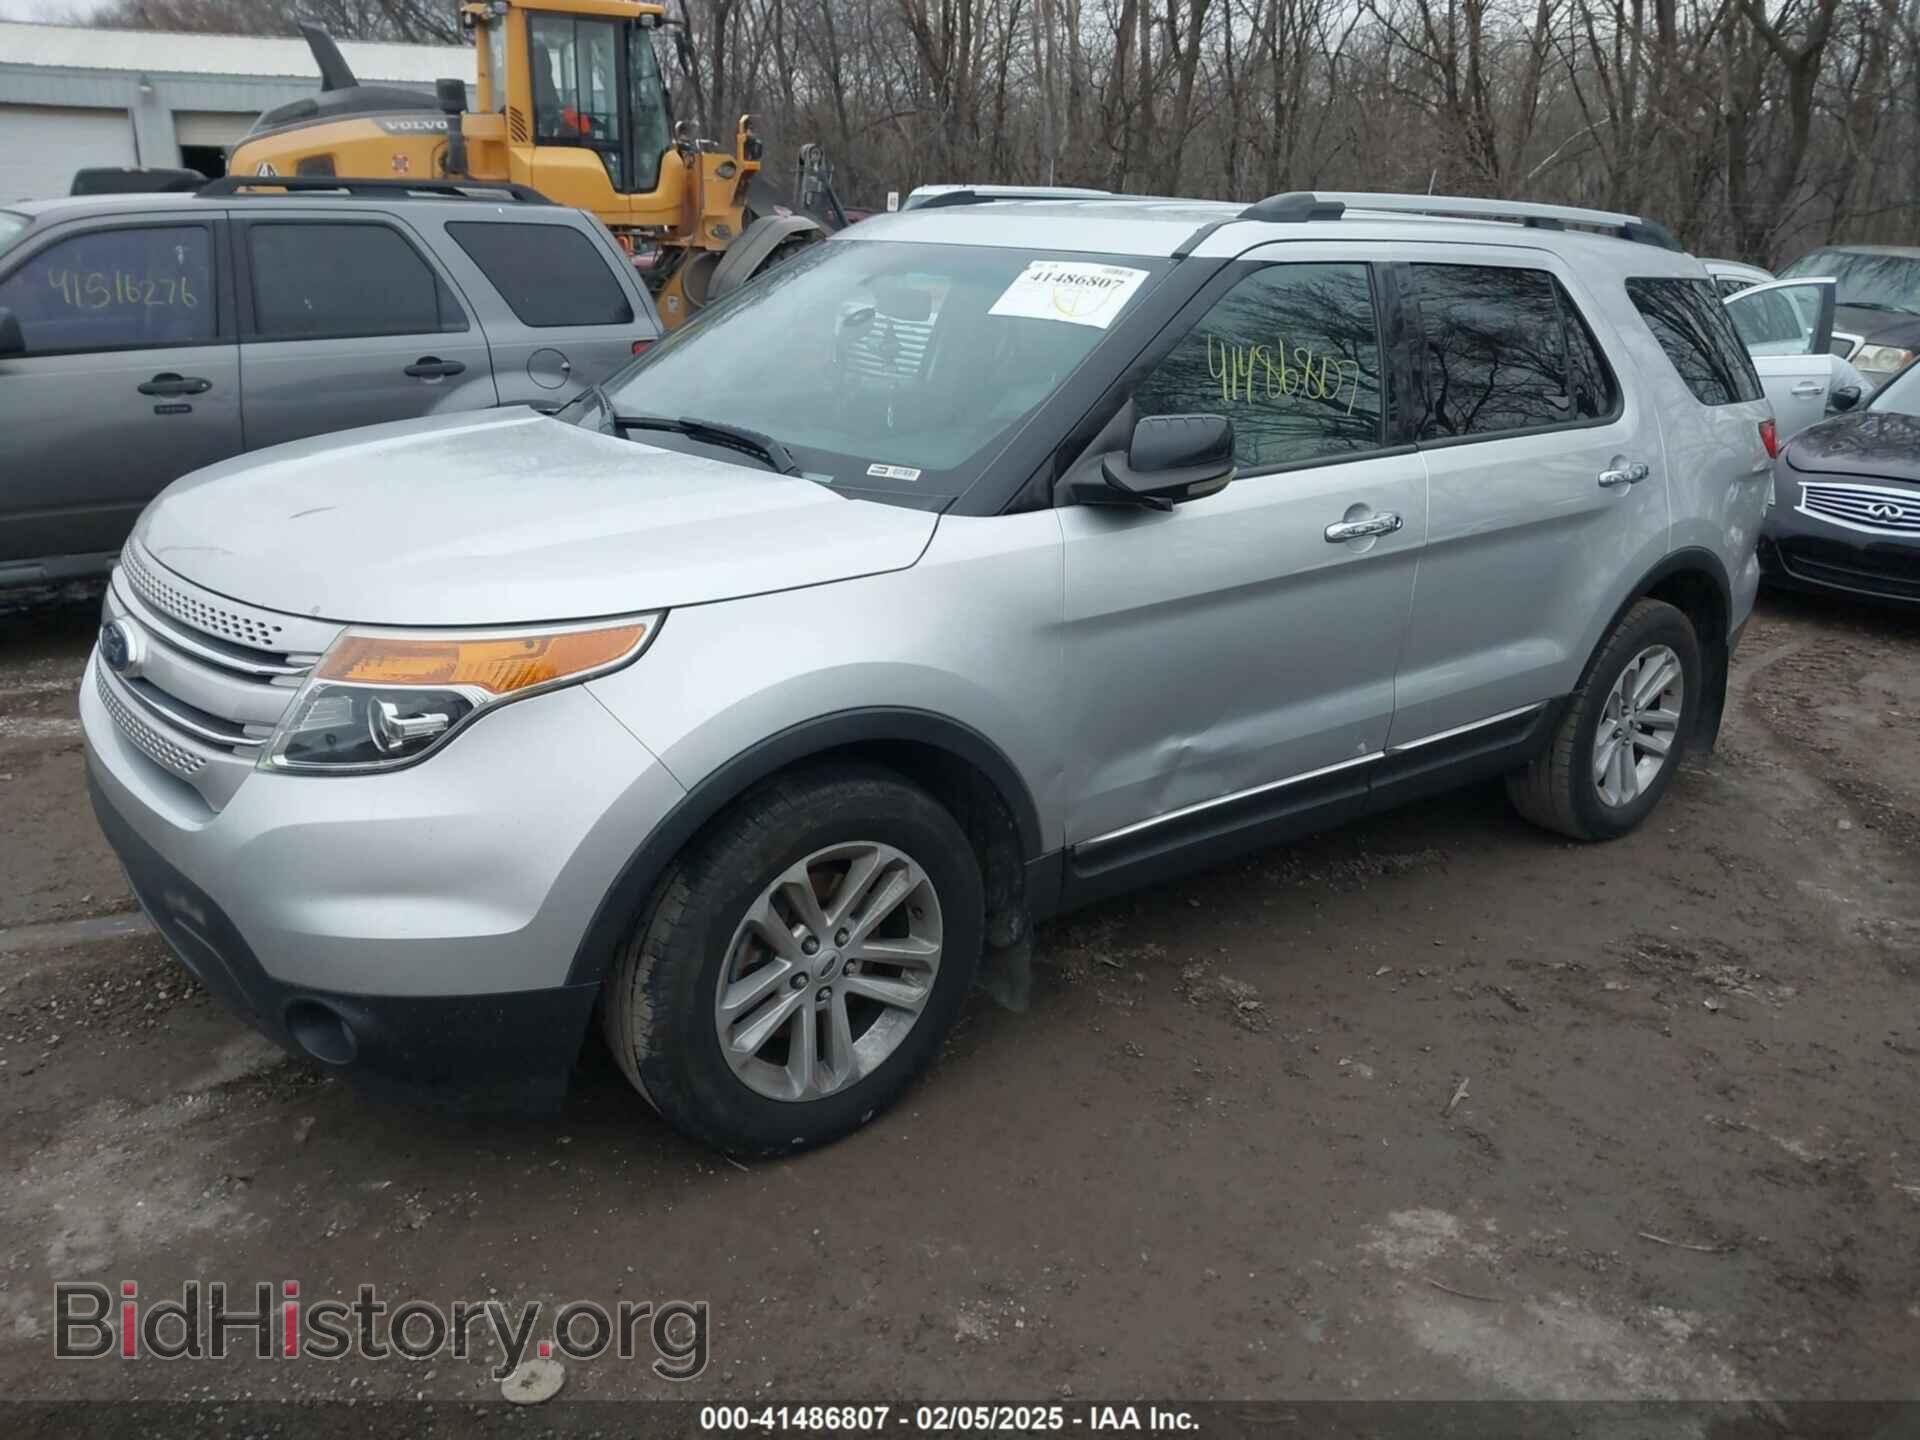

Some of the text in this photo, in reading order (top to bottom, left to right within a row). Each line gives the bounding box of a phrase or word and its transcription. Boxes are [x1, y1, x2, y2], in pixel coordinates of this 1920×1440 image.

[384, 120, 449, 129] VOLVO
[1030, 271, 1125, 289] 41486807
[1207, 333, 1360, 417] 41486807
